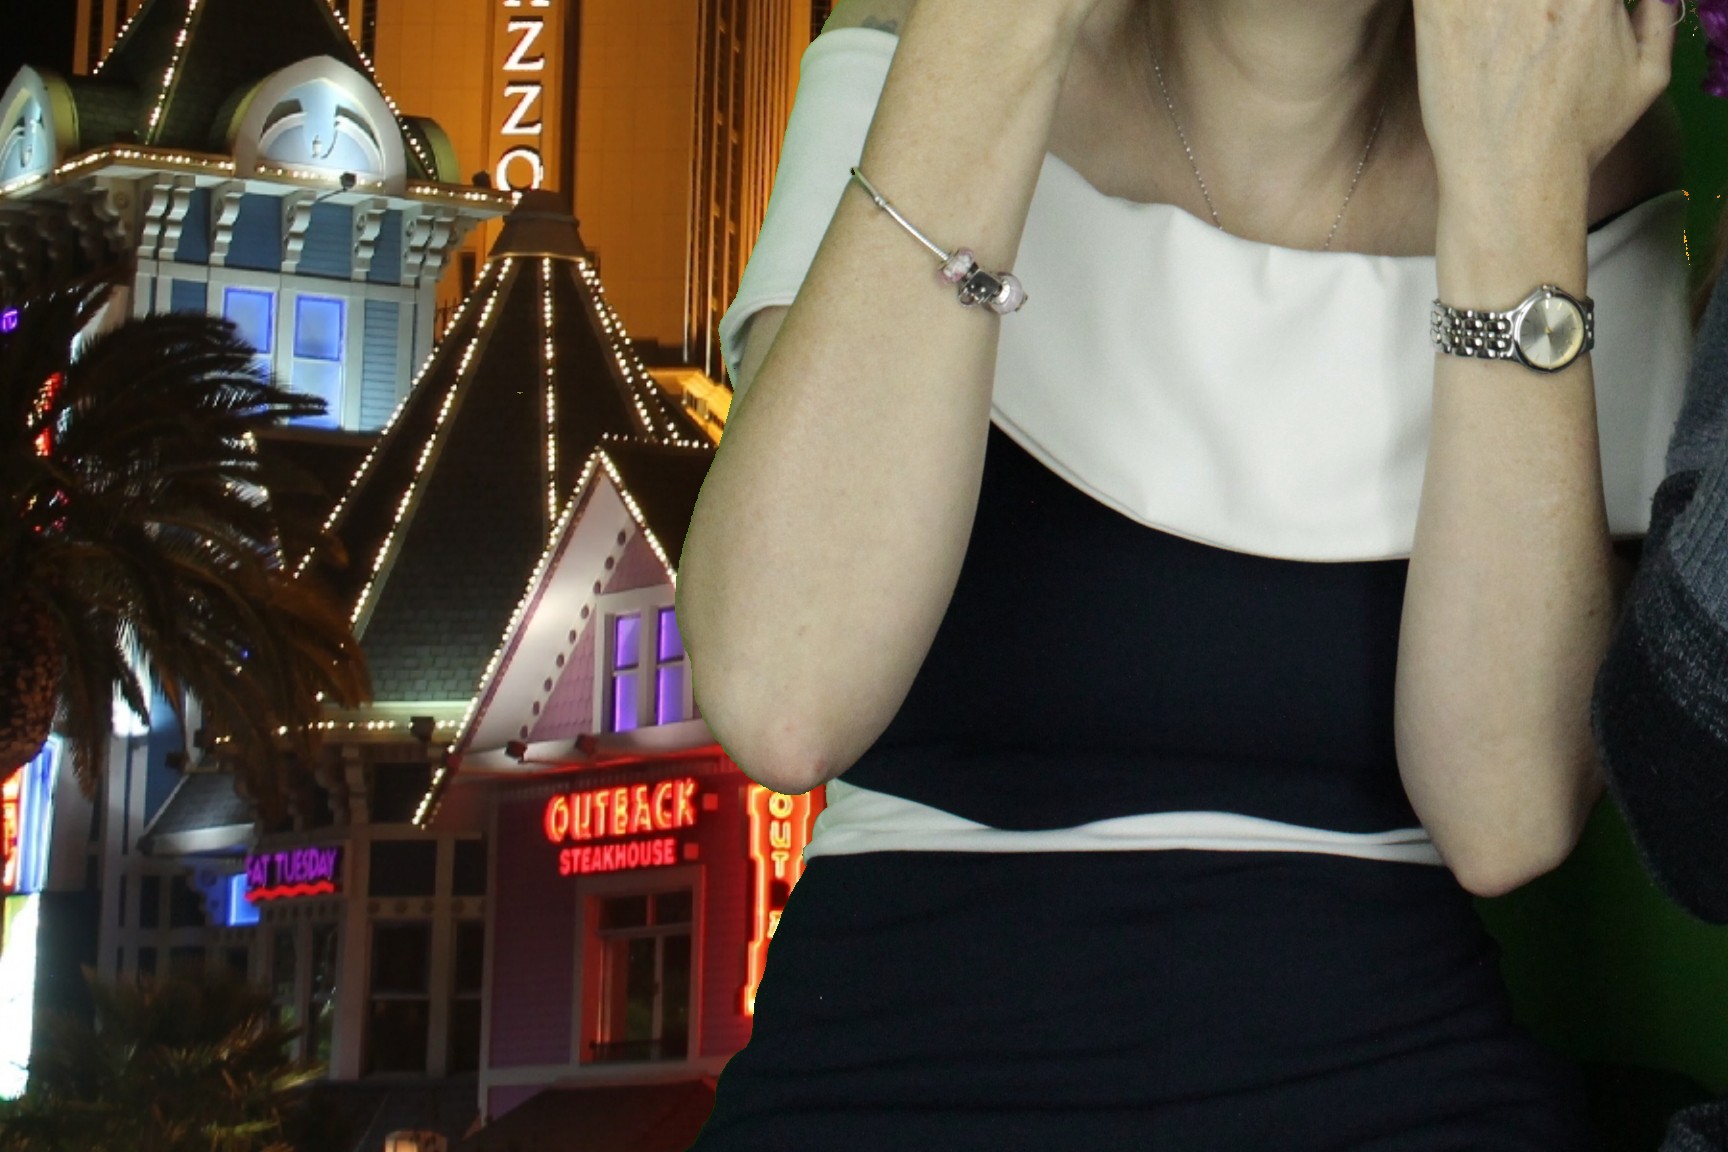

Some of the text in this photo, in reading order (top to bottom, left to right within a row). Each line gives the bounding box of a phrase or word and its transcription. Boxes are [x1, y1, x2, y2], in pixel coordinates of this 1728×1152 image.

[544, 777, 696, 843] OUTBACK
[275, 846, 338, 883] TUESDAY
[558, 837, 677, 876] STEAKHOUSE
